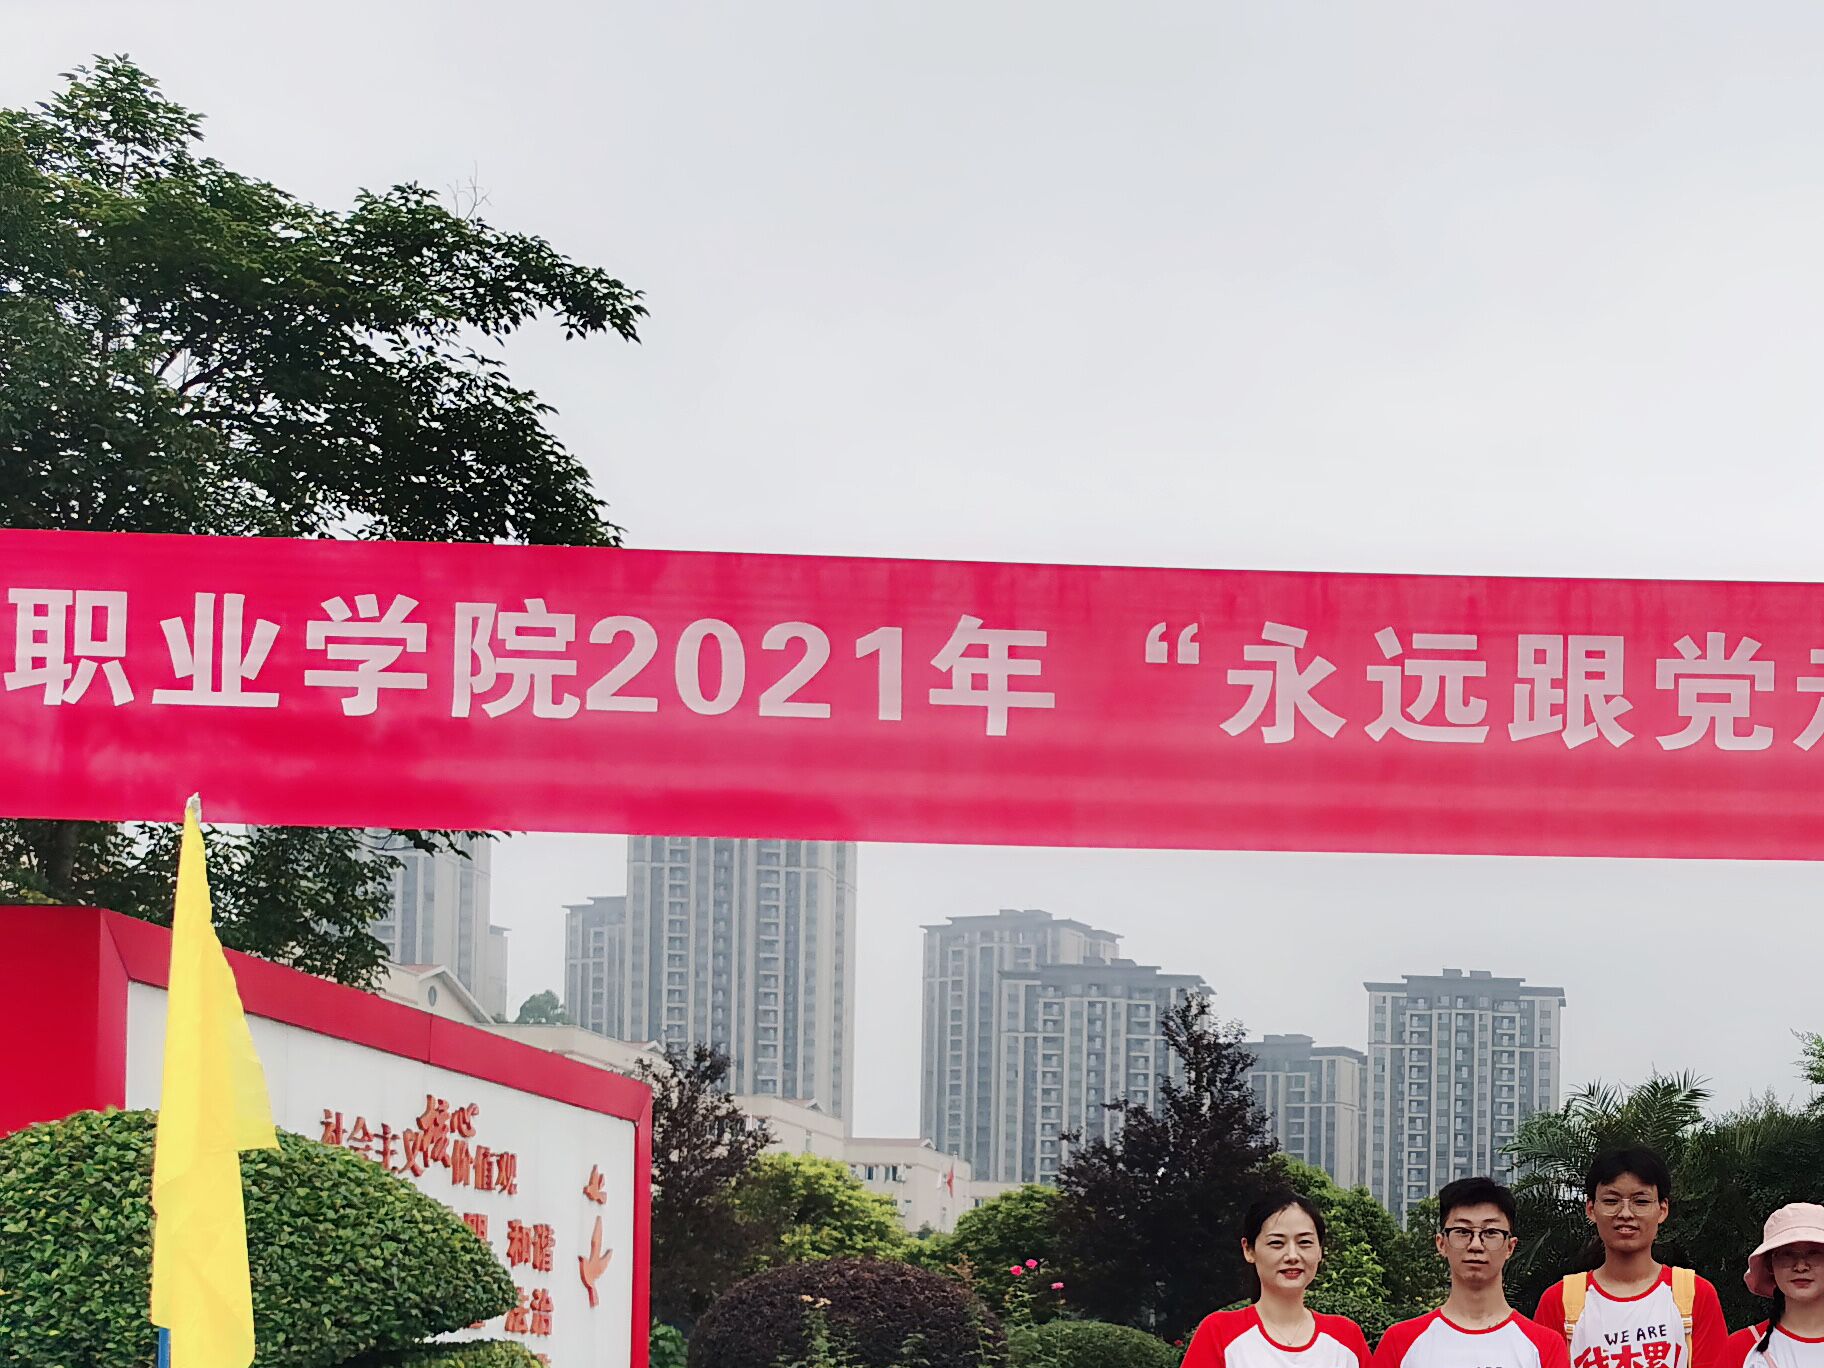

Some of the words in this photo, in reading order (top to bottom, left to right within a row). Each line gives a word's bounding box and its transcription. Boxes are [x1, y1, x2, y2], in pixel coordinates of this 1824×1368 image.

[507, 1219, 555, 1272] 和谐
[1604, 1330, 1630, 1346] WE
[1636, 1324, 1667, 1342] ARE
